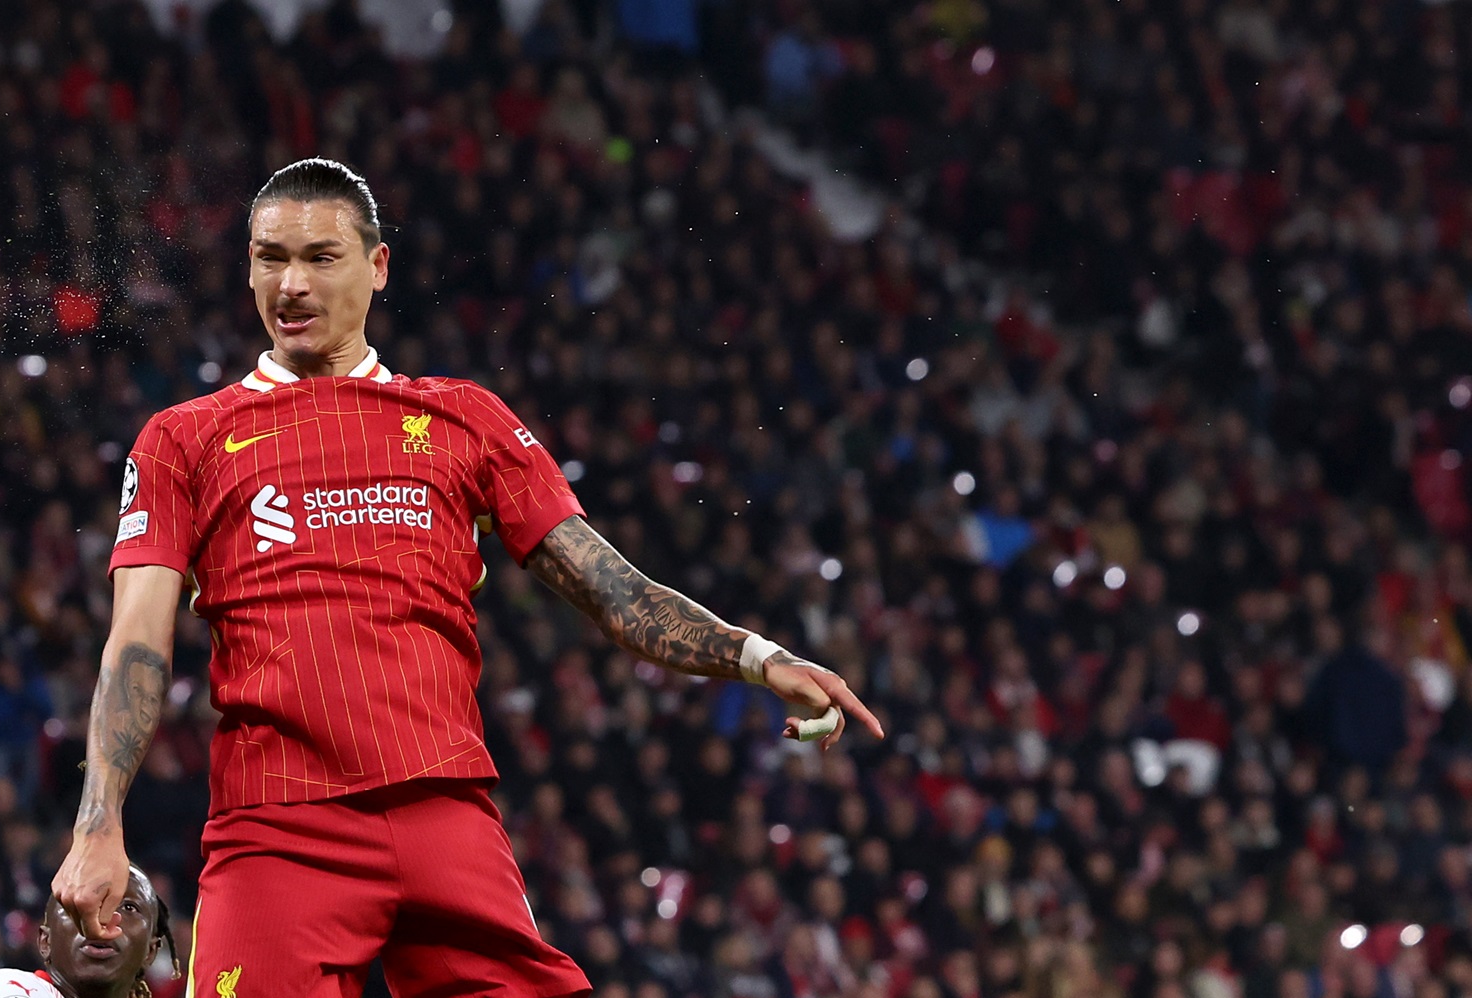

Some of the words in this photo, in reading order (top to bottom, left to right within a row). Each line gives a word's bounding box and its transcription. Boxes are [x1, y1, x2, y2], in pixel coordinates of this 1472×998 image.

[401, 442, 437, 456] L.F.C.
[302, 482, 428, 511] standard
[121, 518, 146, 532] ATION
[305, 504, 433, 530] chartered
